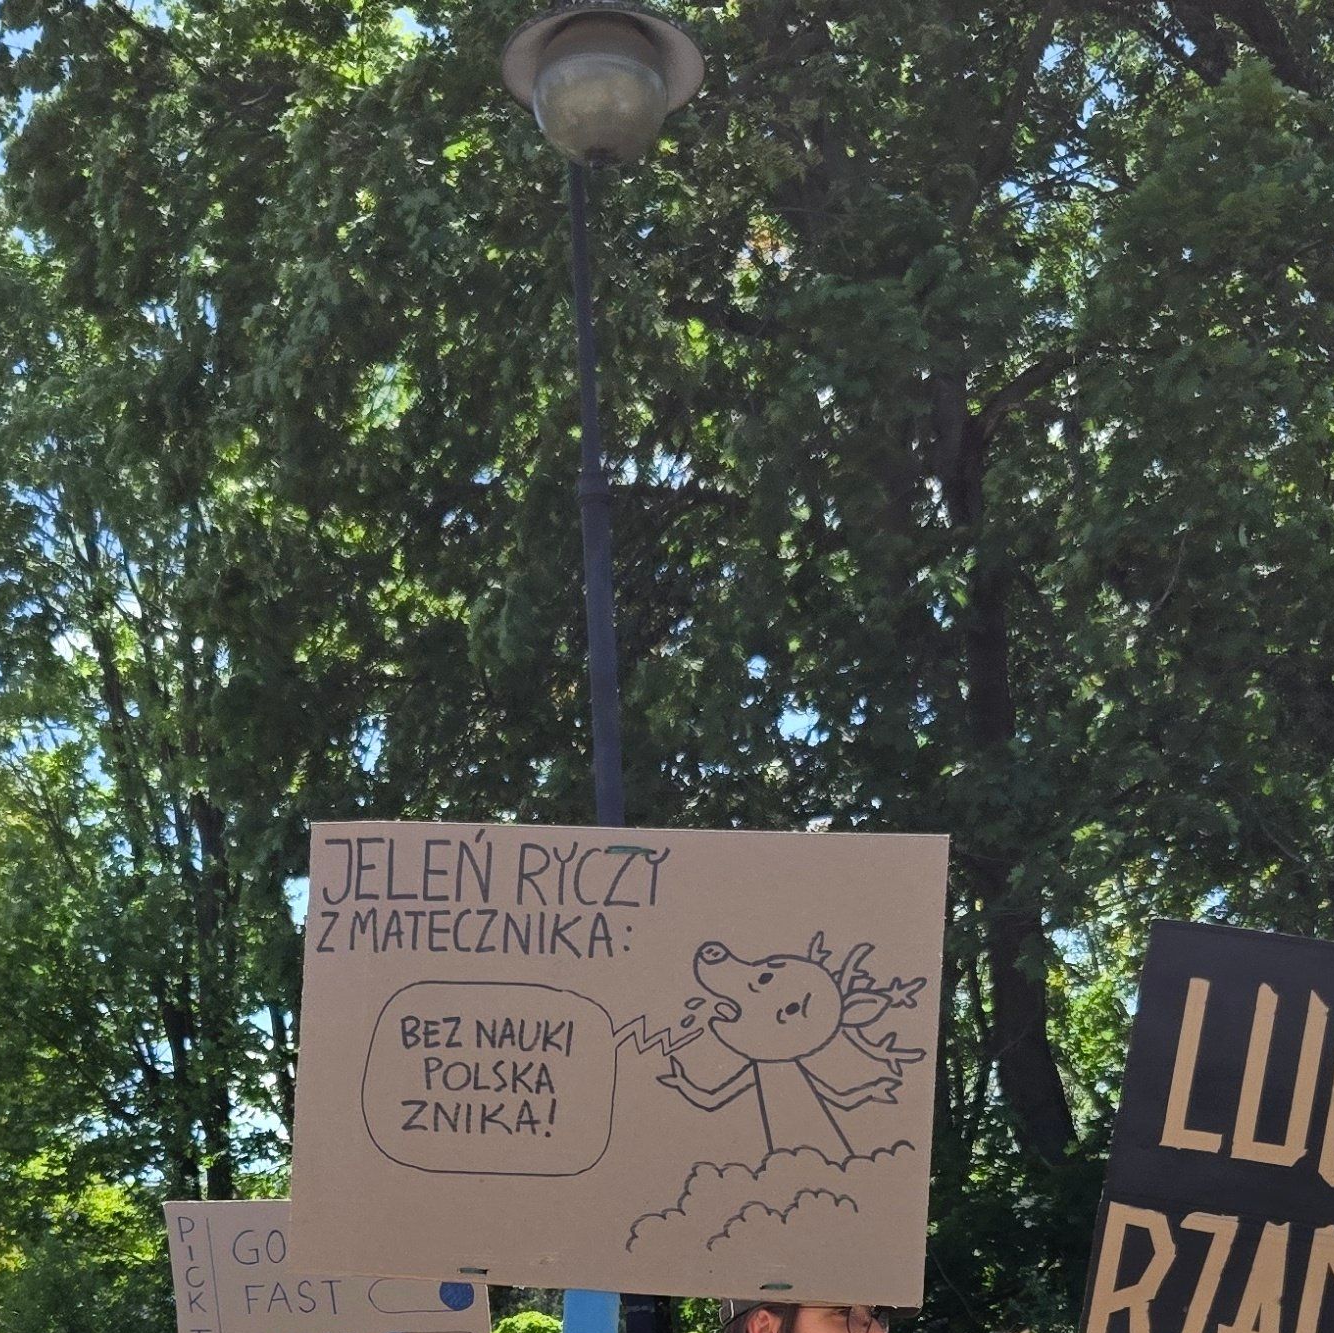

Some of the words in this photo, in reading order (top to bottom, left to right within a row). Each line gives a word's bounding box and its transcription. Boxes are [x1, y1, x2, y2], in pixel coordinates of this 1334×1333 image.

[322, 829, 492, 905] JELEŃ
[517, 841, 670, 906] RYCZY
[317, 911, 340, 952] Z
[349, 908, 633, 958] MATECZNIKA:
[401, 1015, 462, 1049] BEZ
[476, 1018, 573, 1057] NAUKI
[424, 1056, 555, 1094] POLSKA
[401, 1098, 557, 1138] ZNIKA!
[232, 1229, 286, 1265] GO
[245, 1280, 342, 1314] FAST
